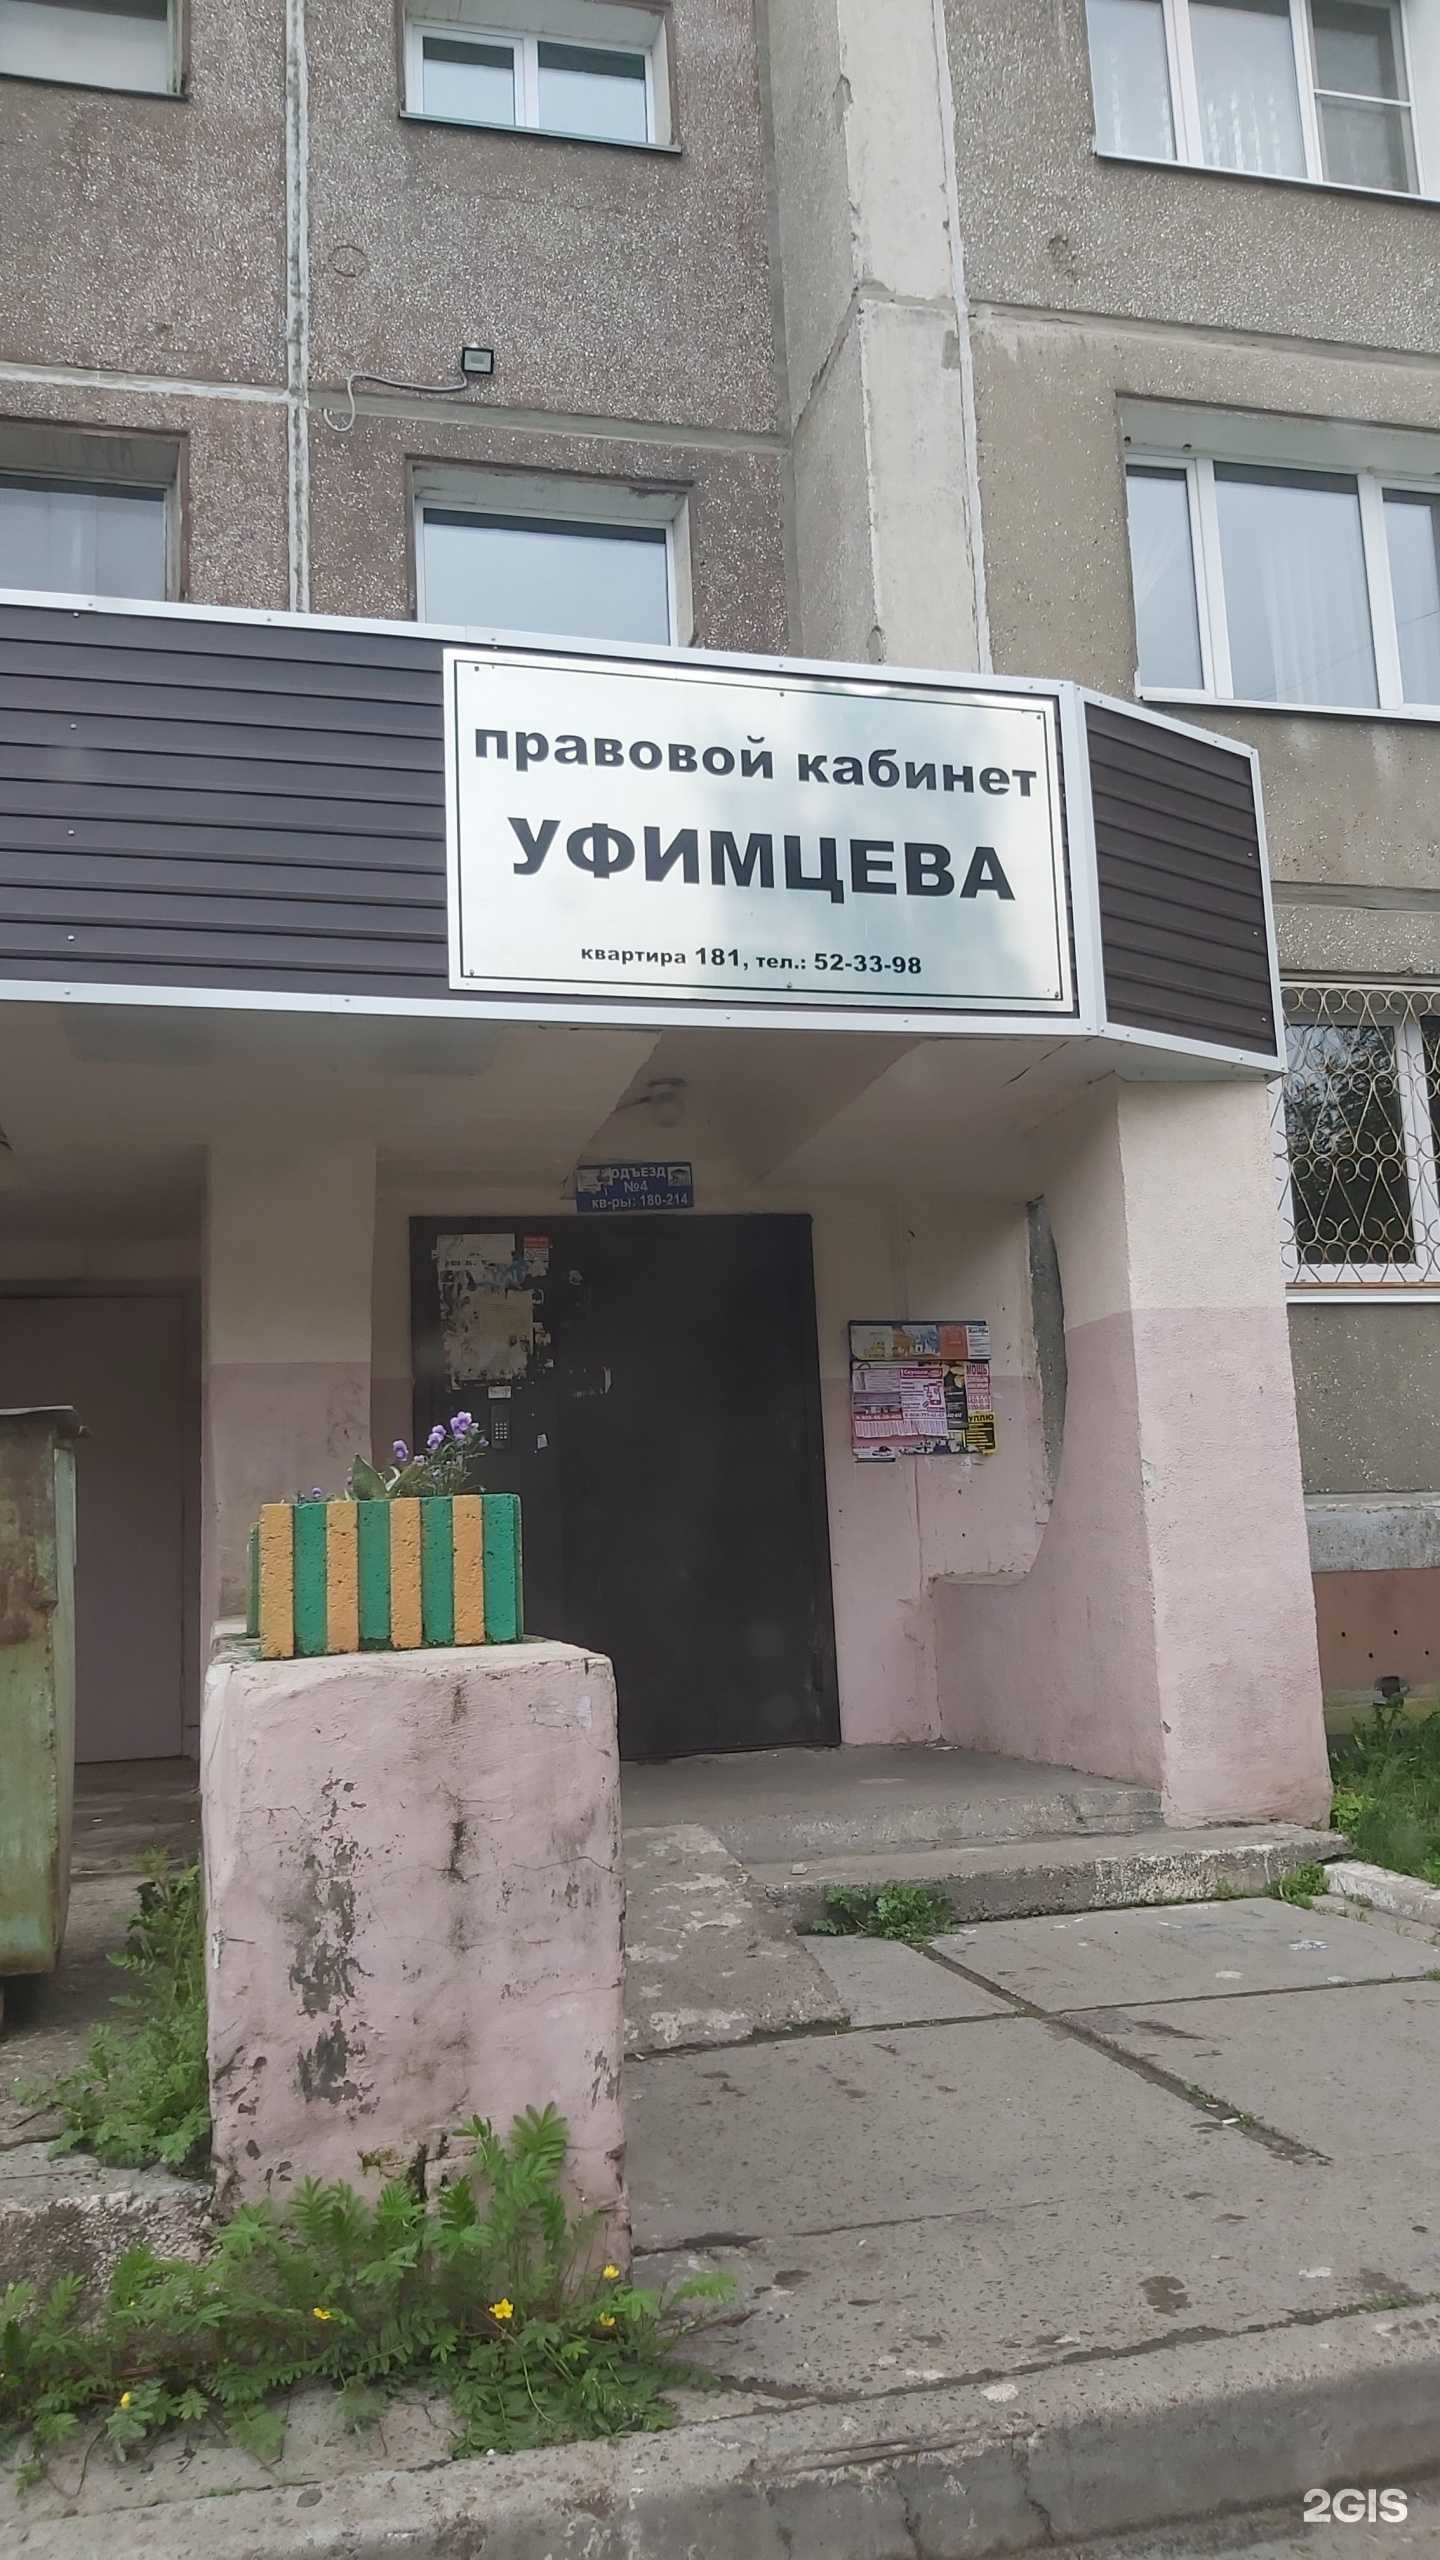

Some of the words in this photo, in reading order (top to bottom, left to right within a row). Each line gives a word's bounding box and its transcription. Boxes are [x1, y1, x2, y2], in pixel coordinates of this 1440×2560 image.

[474, 727, 774, 779] правовой
[797, 748, 1038, 797] кабинет
[507, 816, 1016, 905] УФИМЦЕВА
[580, 947, 687, 967] квартира
[695, 947, 750, 972] 181,
[755, 955, 807, 971] тел.:
[813, 952, 923, 976] 52-33-98
[607, 1166, 667, 1180] ОДЪЕЗД
[623, 1180, 649, 1193] №4
[639, 1192, 689, 1207] 180-214
